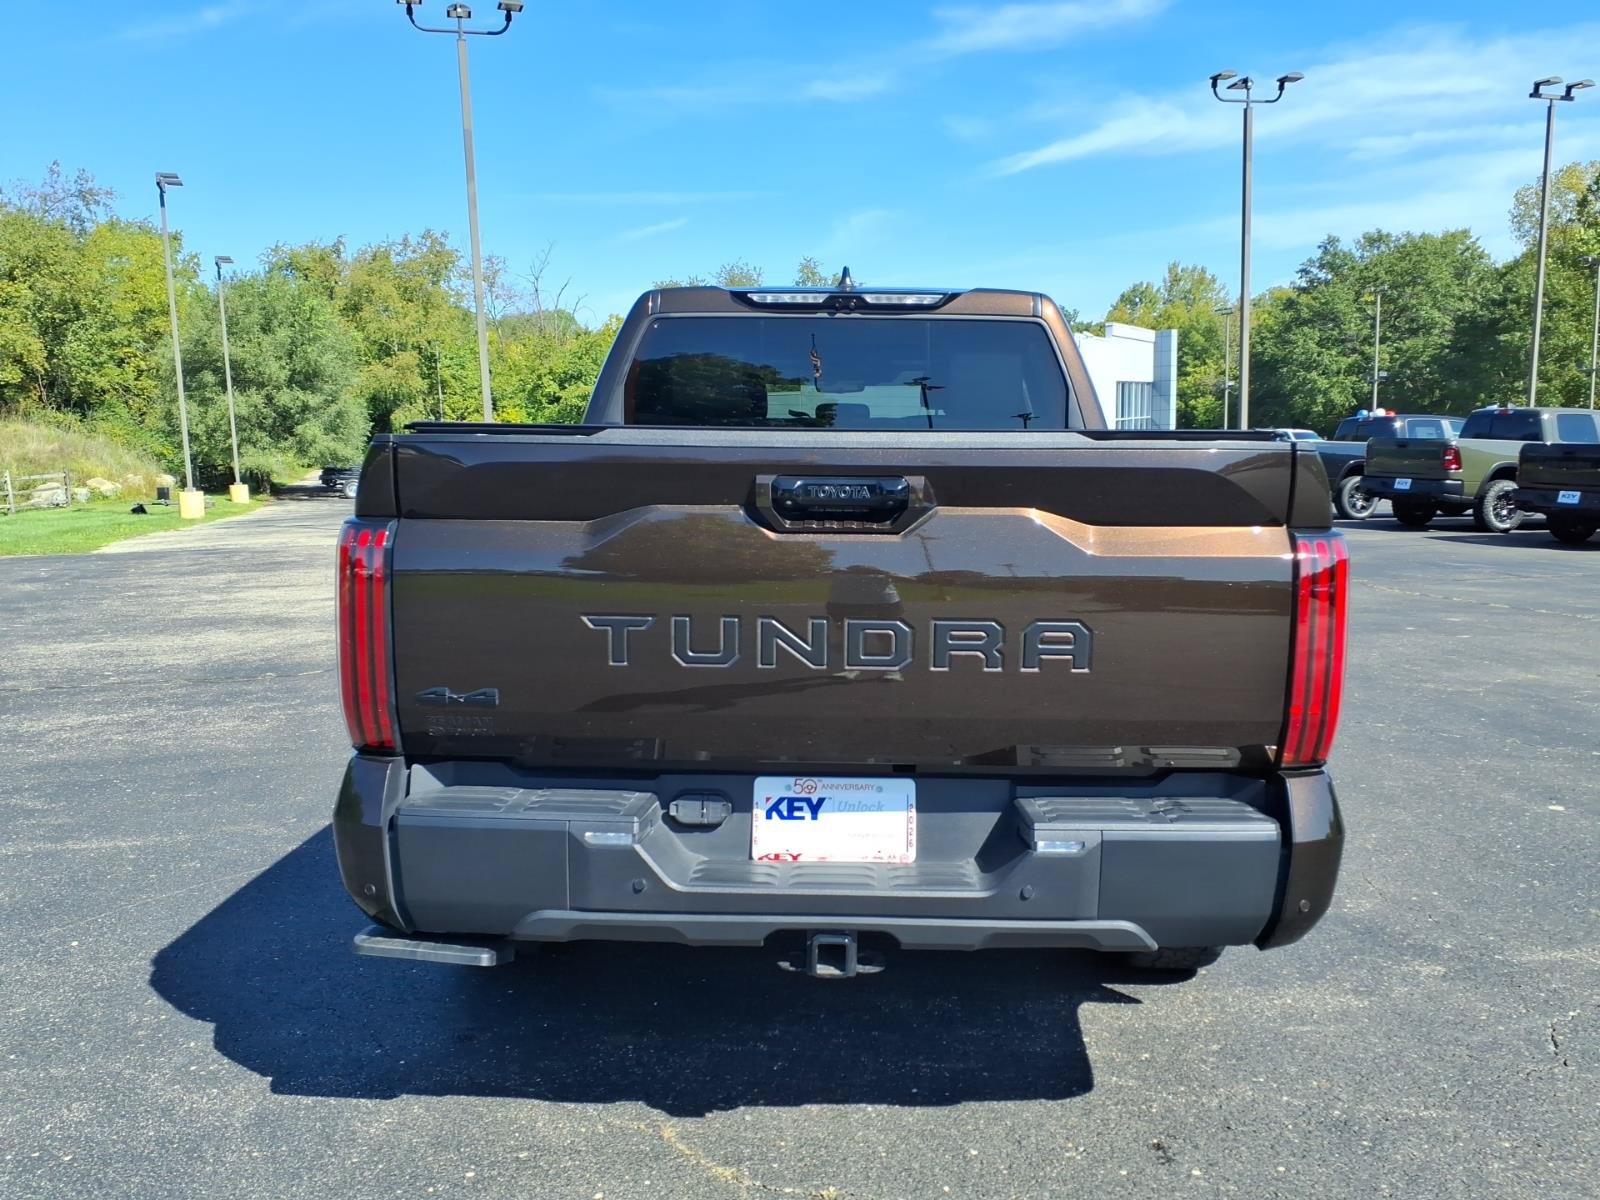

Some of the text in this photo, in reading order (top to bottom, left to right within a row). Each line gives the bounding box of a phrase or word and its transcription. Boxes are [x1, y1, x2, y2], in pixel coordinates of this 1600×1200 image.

[808, 485, 871, 499] TOYOTA
[580, 615, 1094, 674] TUNDRA
[793, 778, 875, 794] 50 ANNIVERSARY
[765, 796, 827, 820] KEY
[838, 800, 885, 812] Unlock
